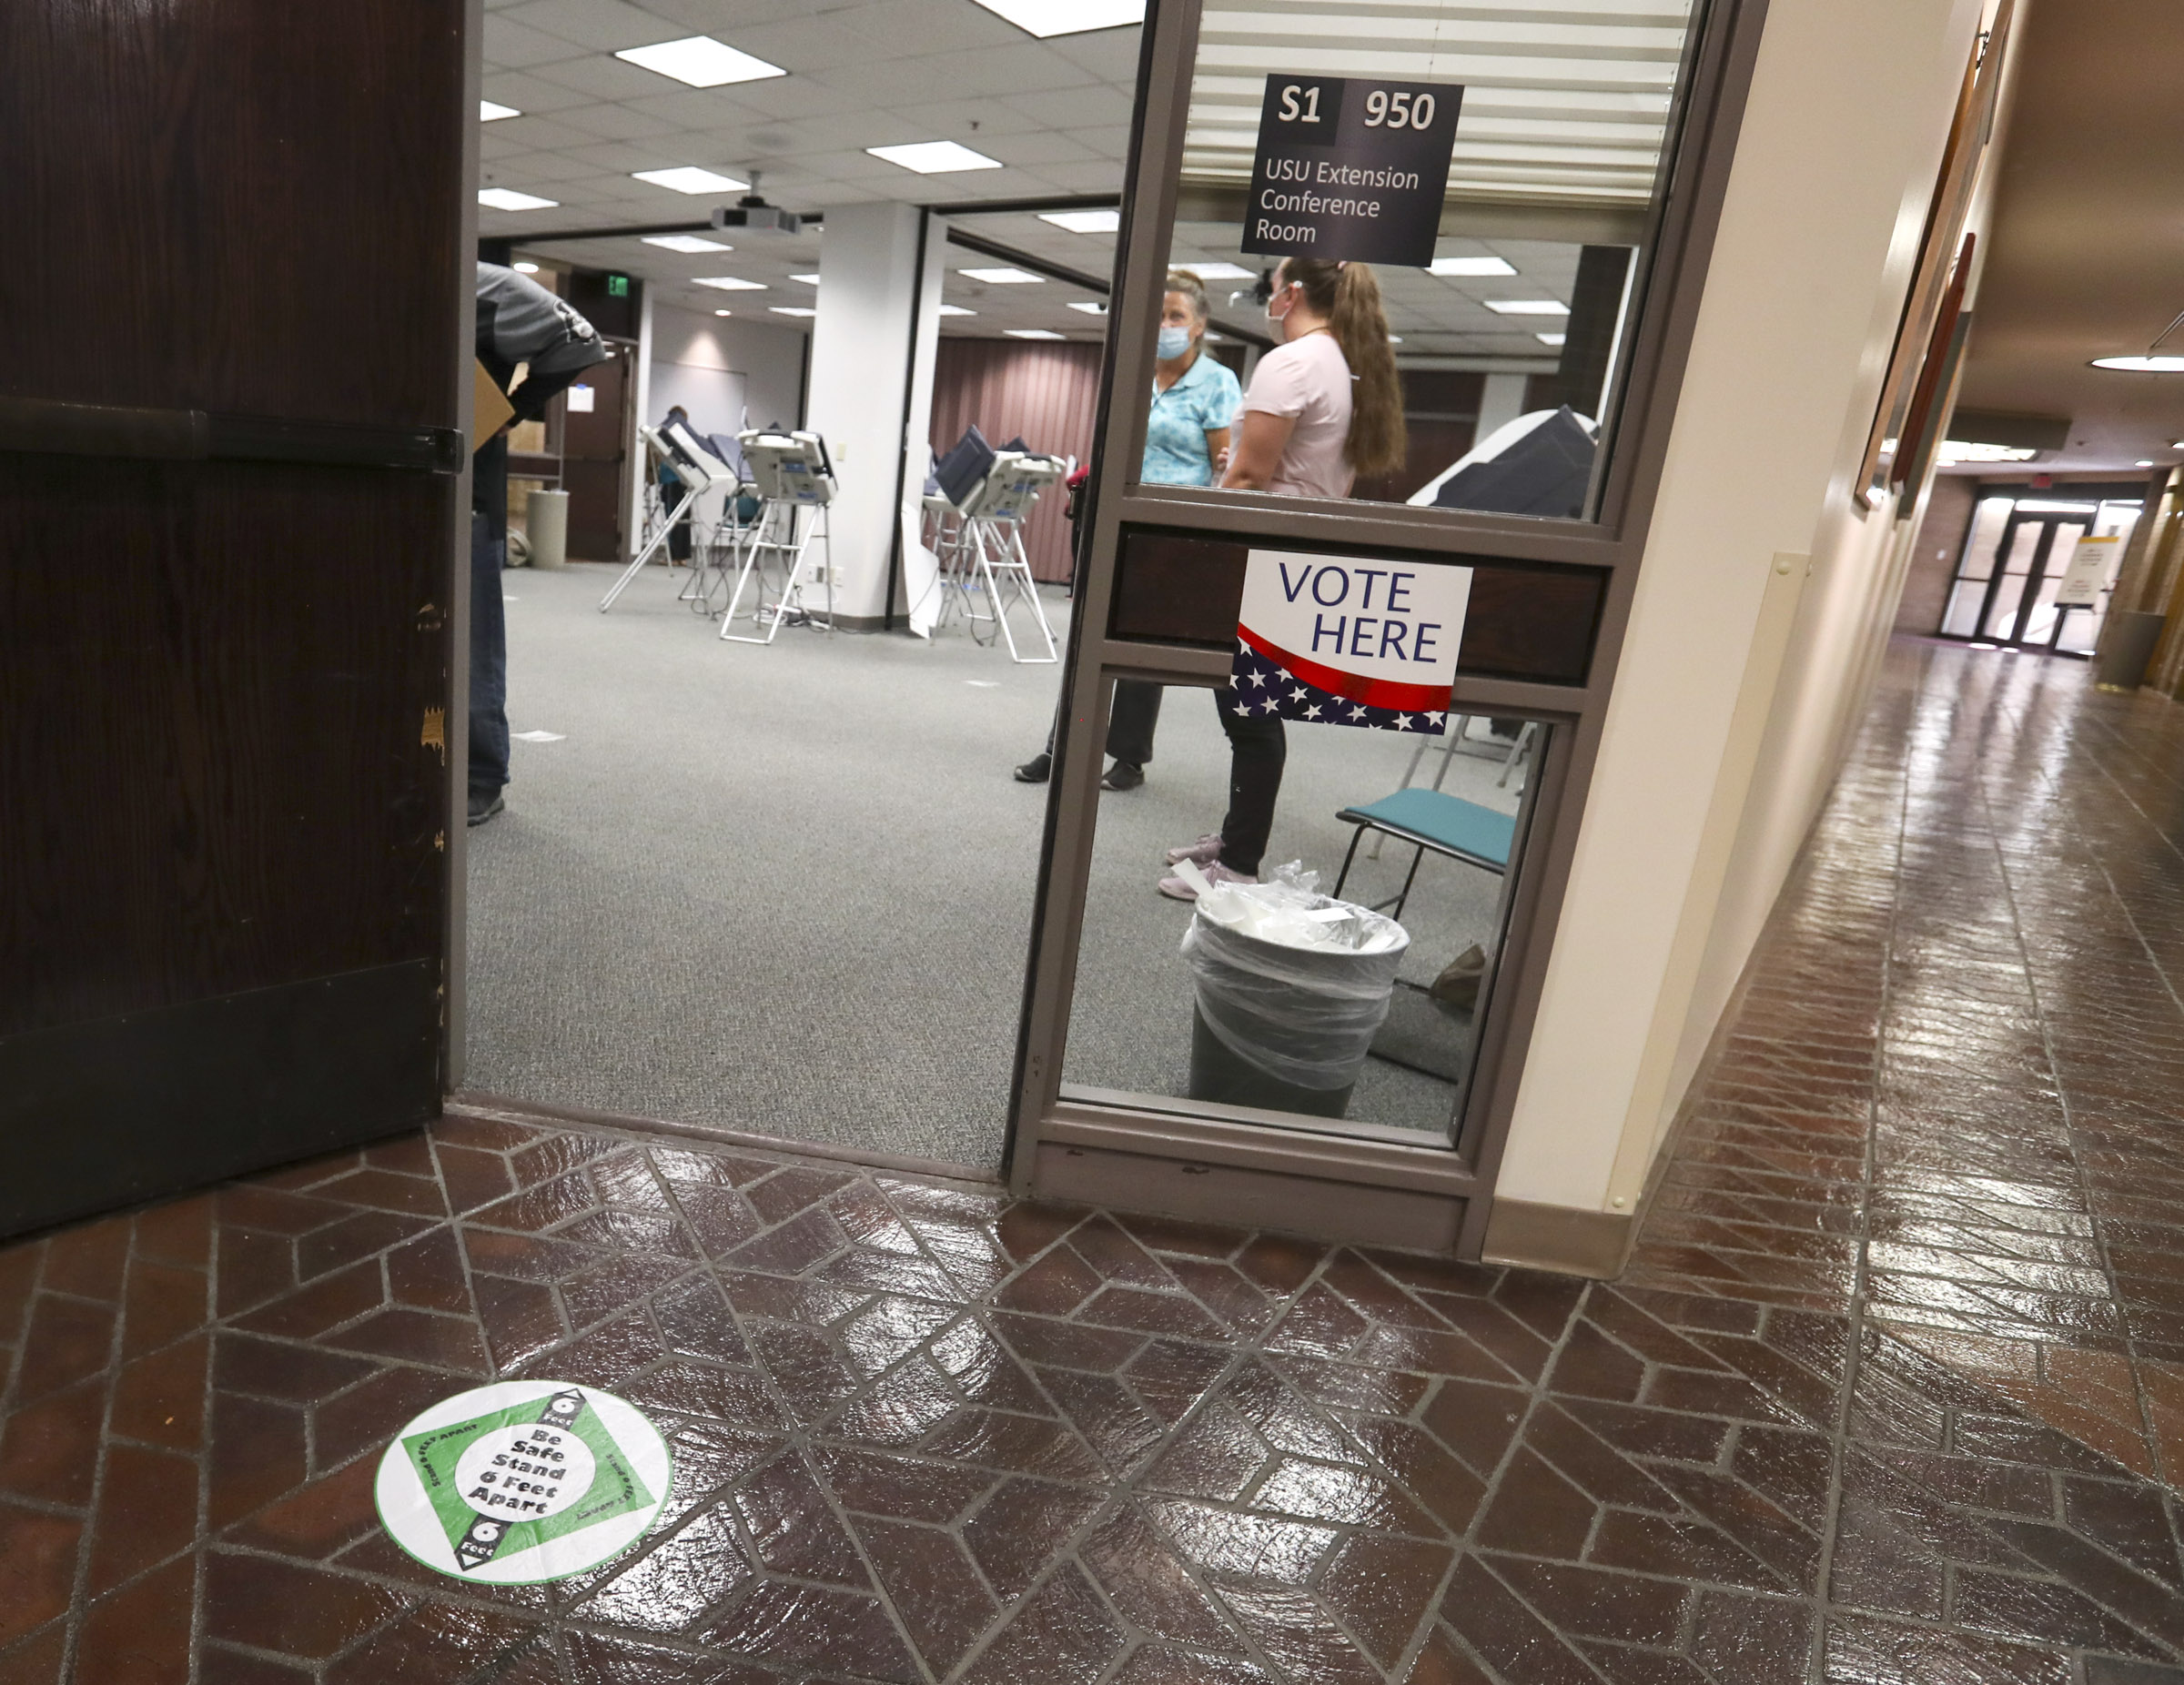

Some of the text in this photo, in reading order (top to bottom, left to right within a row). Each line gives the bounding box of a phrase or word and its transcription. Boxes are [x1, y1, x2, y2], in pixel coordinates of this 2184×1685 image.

[1279, 86, 1435, 130] S1 950
[1266, 158, 1419, 189] USU Extension
[1260, 189, 1380, 217] Conference
[1256, 218, 1316, 243] Room
[1279, 562, 1415, 612] VOTE
[1311, 613, 1441, 663] HERE
[552, 1397, 578, 1413] 6
[543, 1413, 572, 1426] Feet
[531, 1429, 561, 1445] Be
[511, 1440, 564, 1462] Safe
[491, 1454, 566, 1480] Stand
[480, 1471, 558, 1498] 6 Feet
[468, 1487, 548, 1514] Apart
[472, 1521, 501, 1541] 6
[460, 1541, 494, 1556] Feet
